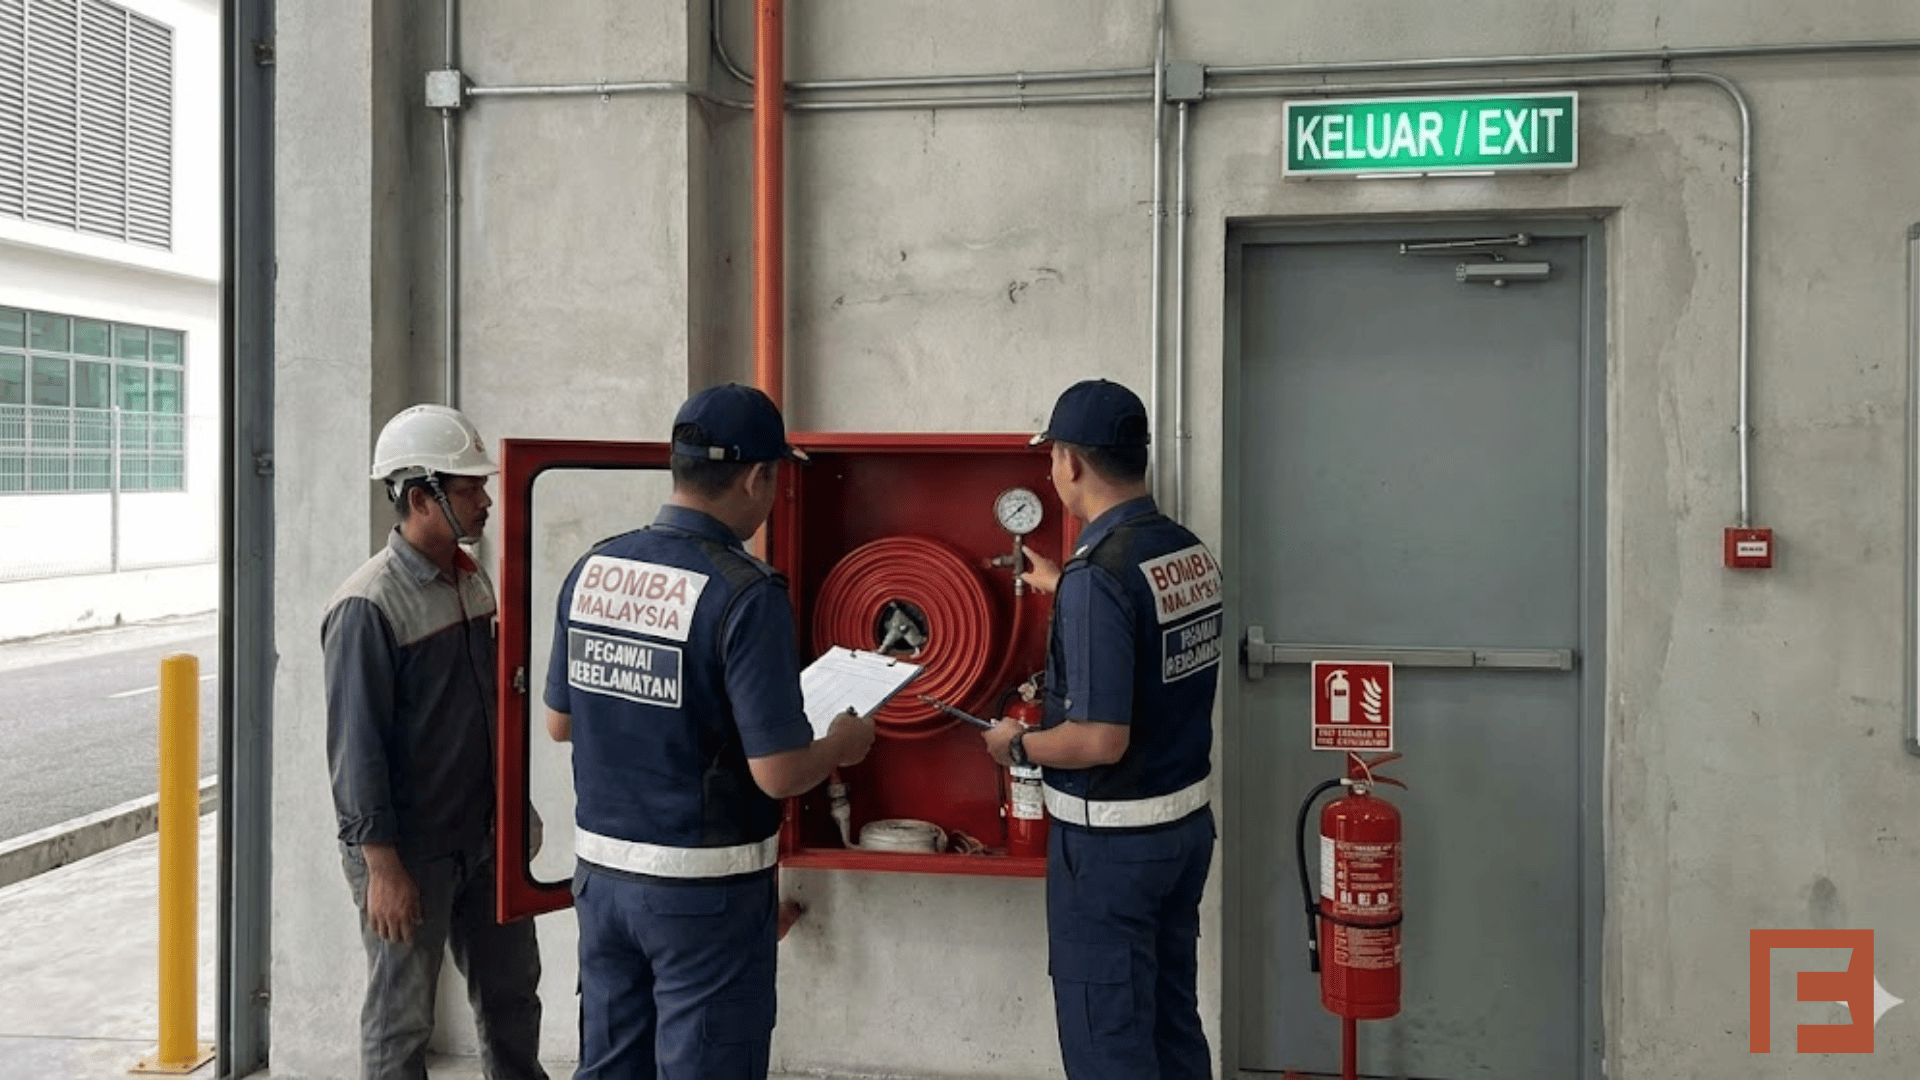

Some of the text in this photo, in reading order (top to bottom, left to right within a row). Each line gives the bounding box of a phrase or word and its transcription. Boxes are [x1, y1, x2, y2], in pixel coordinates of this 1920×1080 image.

[1297, 107, 1564, 161] KELUAR / EXIT
[583, 563, 687, 606] BOMBA
[1150, 552, 1214, 591] BOMBA
[577, 594, 680, 631] MALAYSIA
[584, 638, 653, 671] PEGAWAI
